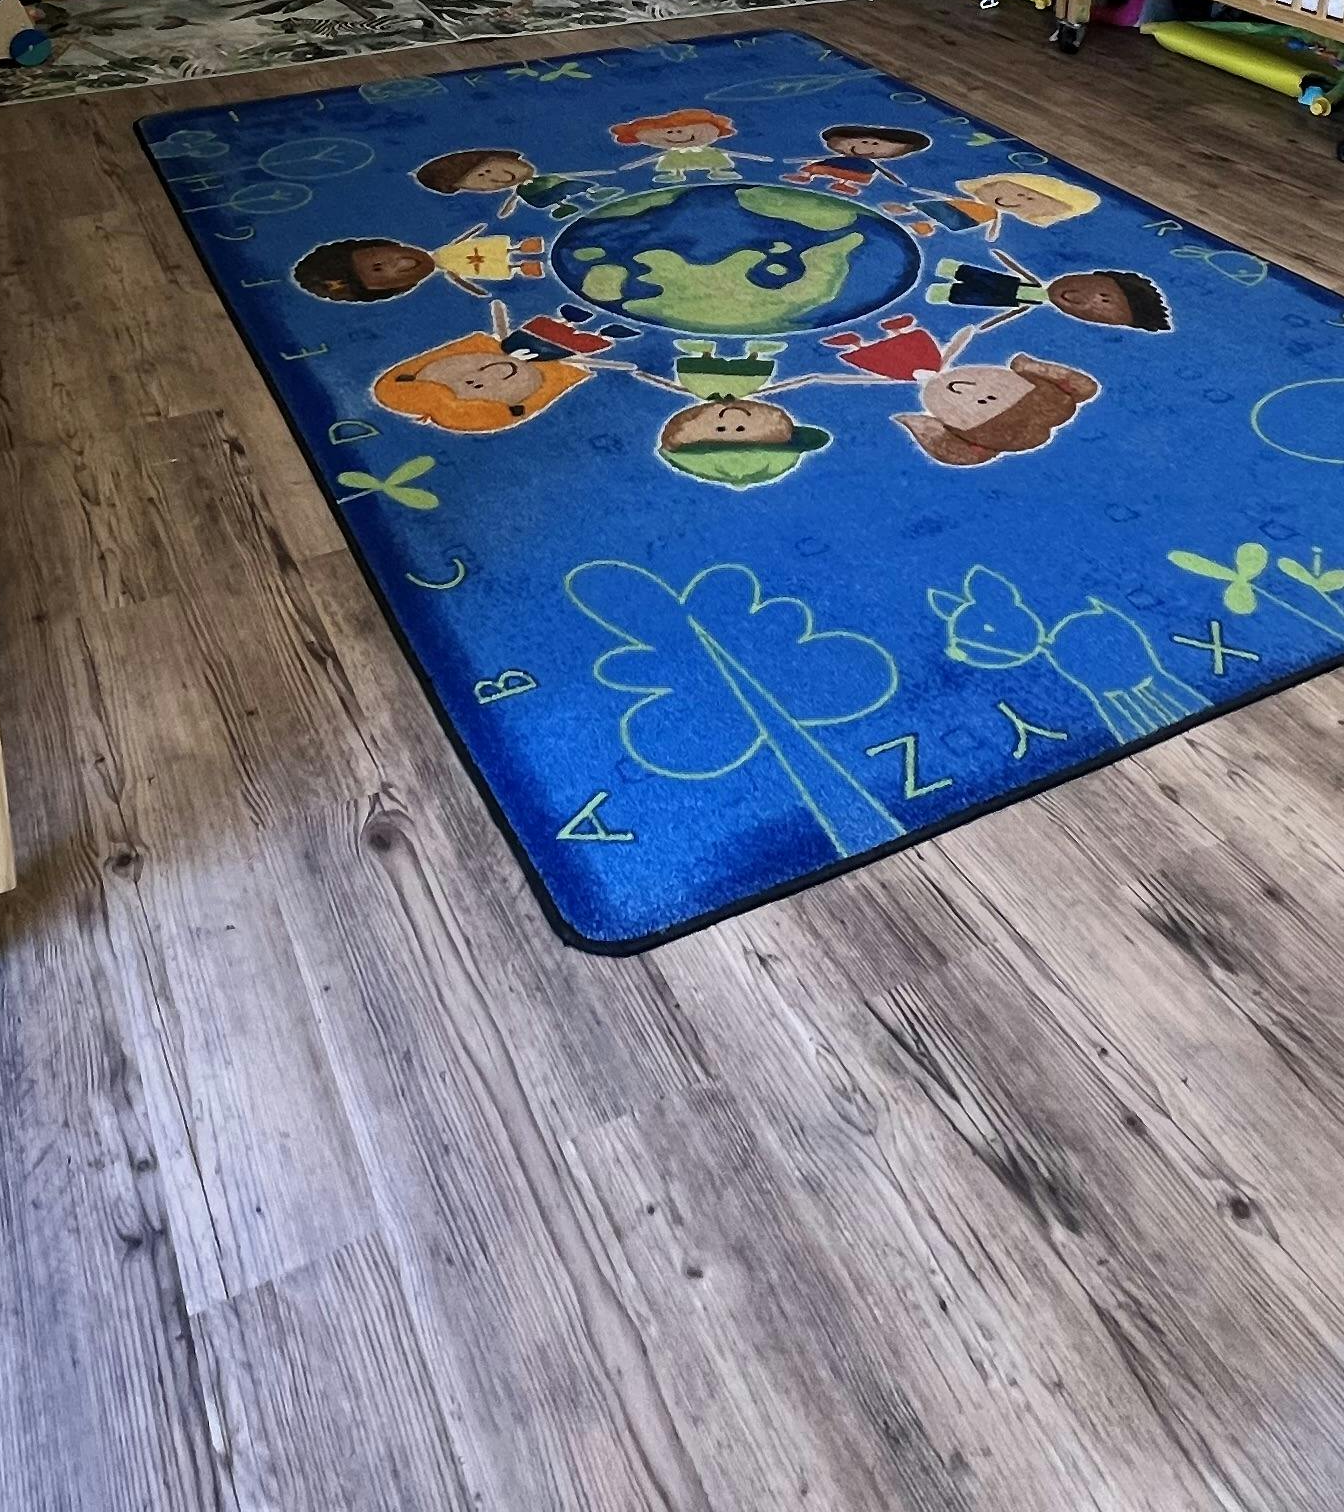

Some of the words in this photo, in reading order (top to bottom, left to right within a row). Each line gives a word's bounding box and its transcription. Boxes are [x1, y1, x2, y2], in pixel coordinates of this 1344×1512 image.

[889, 91, 926, 105] O
[1144, 220, 1183, 236] R
[188, 175, 224, 193] H
[214, 224, 256, 241] G
[240, 278, 283, 289] F
[280, 340, 329, 362] E
[328, 418, 380, 447] D
[406, 556, 465, 593] C
[1173, 619, 1261, 676] X
[474, 670, 537, 704] B
[997, 702, 1069, 761] Y
[866, 733, 953, 801] Z
[558, 792, 634, 841] A
